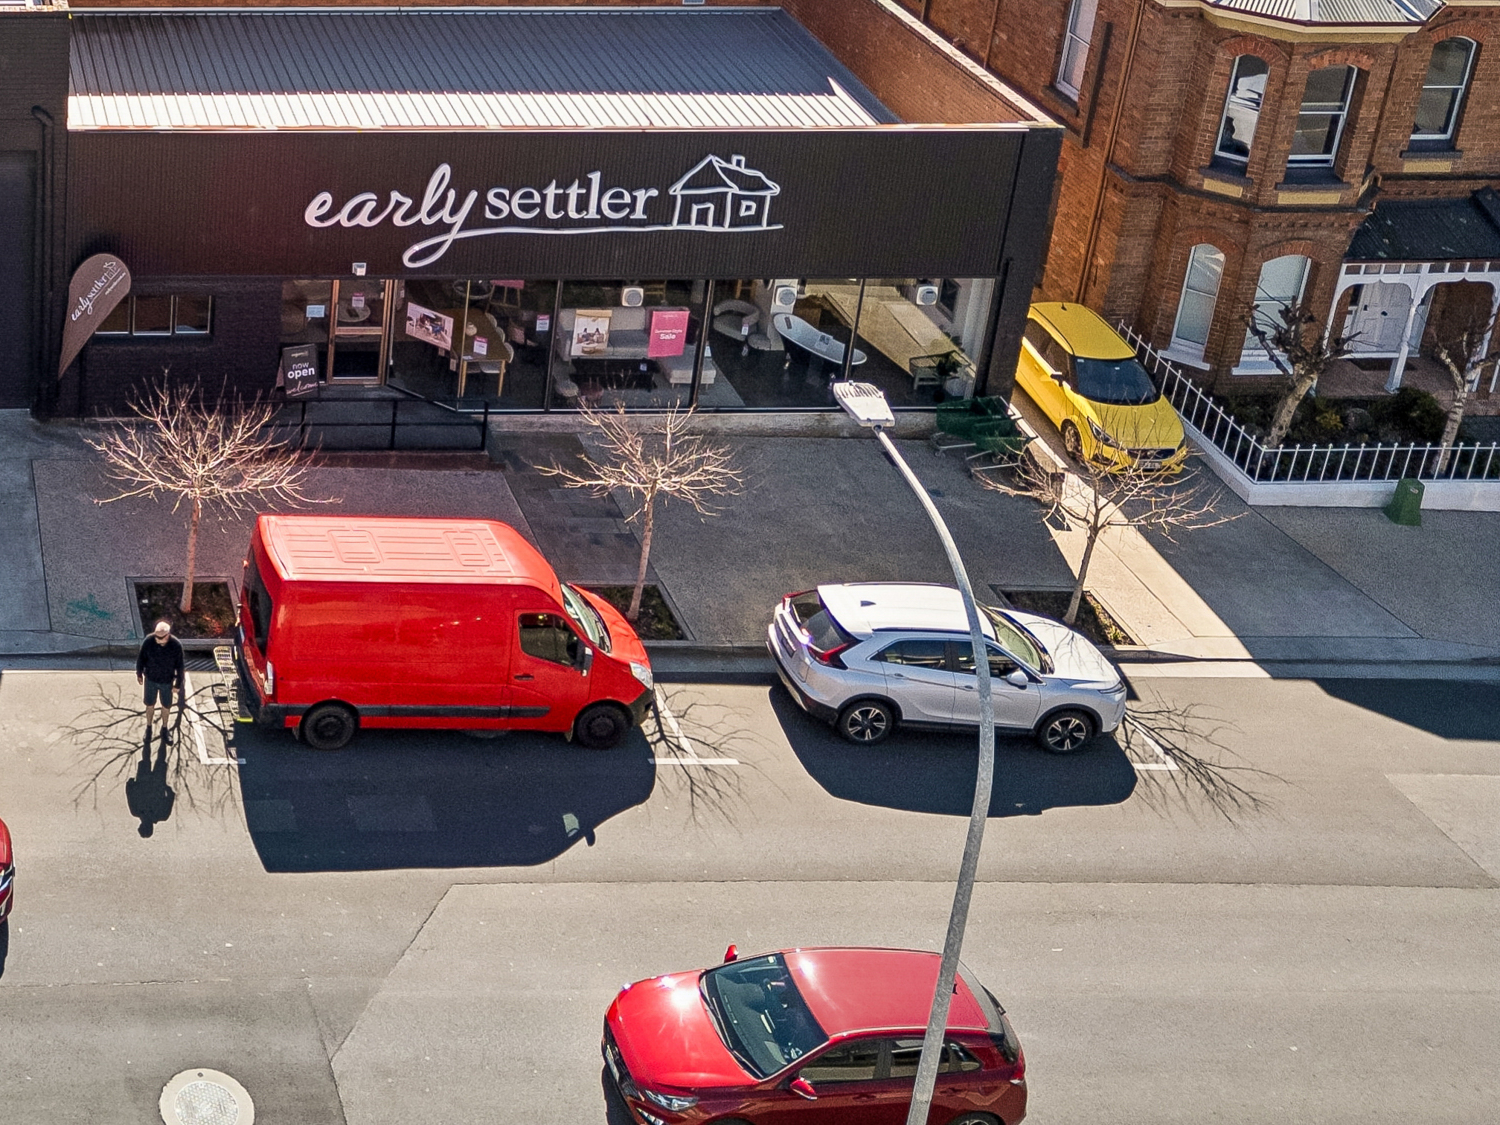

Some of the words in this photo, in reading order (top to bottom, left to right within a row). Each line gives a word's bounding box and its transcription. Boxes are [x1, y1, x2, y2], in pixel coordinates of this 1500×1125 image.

[303, 162, 479, 269] early
[483, 170, 660, 221] settler
[71, 296, 93, 322] early
[287, 367, 315, 380] open
[292, 362, 310, 370] now
